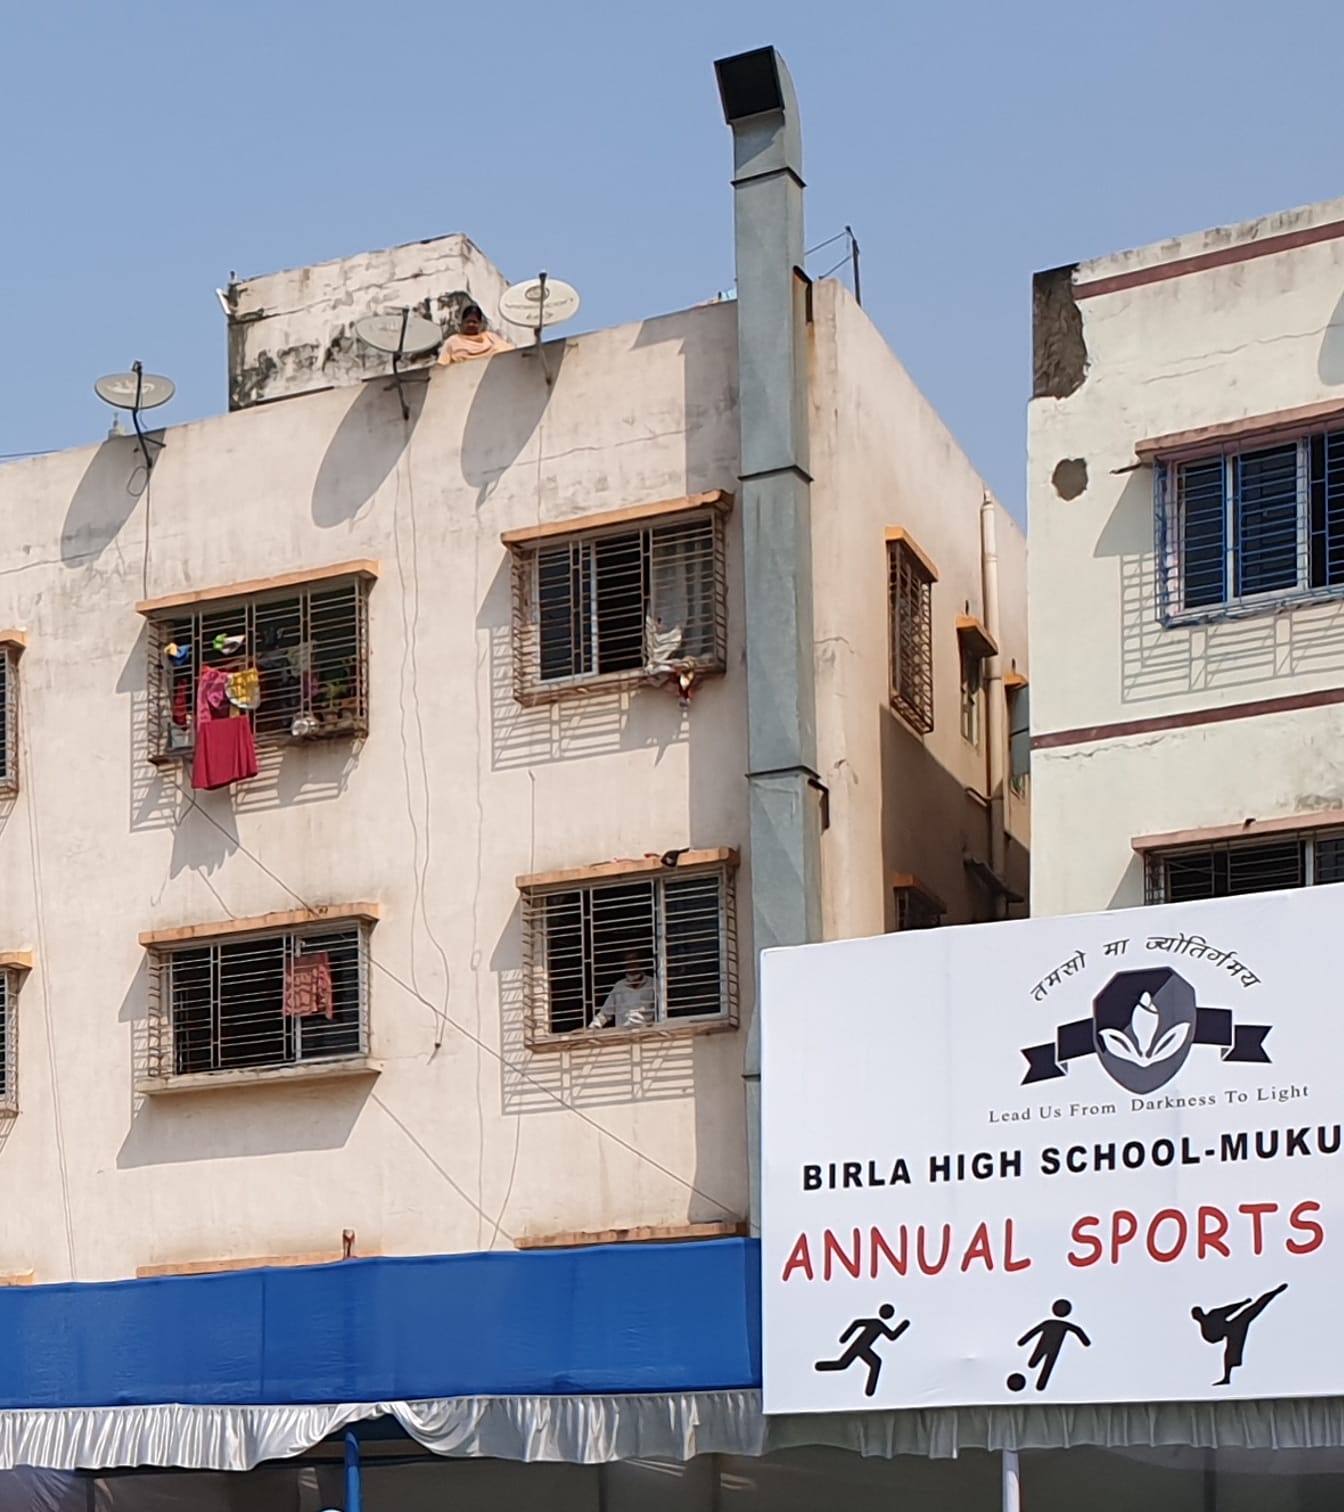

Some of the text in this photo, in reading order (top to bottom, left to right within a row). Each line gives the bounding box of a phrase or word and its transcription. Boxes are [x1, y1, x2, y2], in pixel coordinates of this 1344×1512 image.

[1030, 932, 1262, 1002] तमसो मा ज्योतिर्गमय
[989, 1084, 1309, 1123] Lead Us From Darkness To Light
[803, 1158, 912, 1191] BIRLA
[929, 1150, 1022, 1183] HIGH
[782, 1200, 1325, 1282] ANNUAL SPORTS
